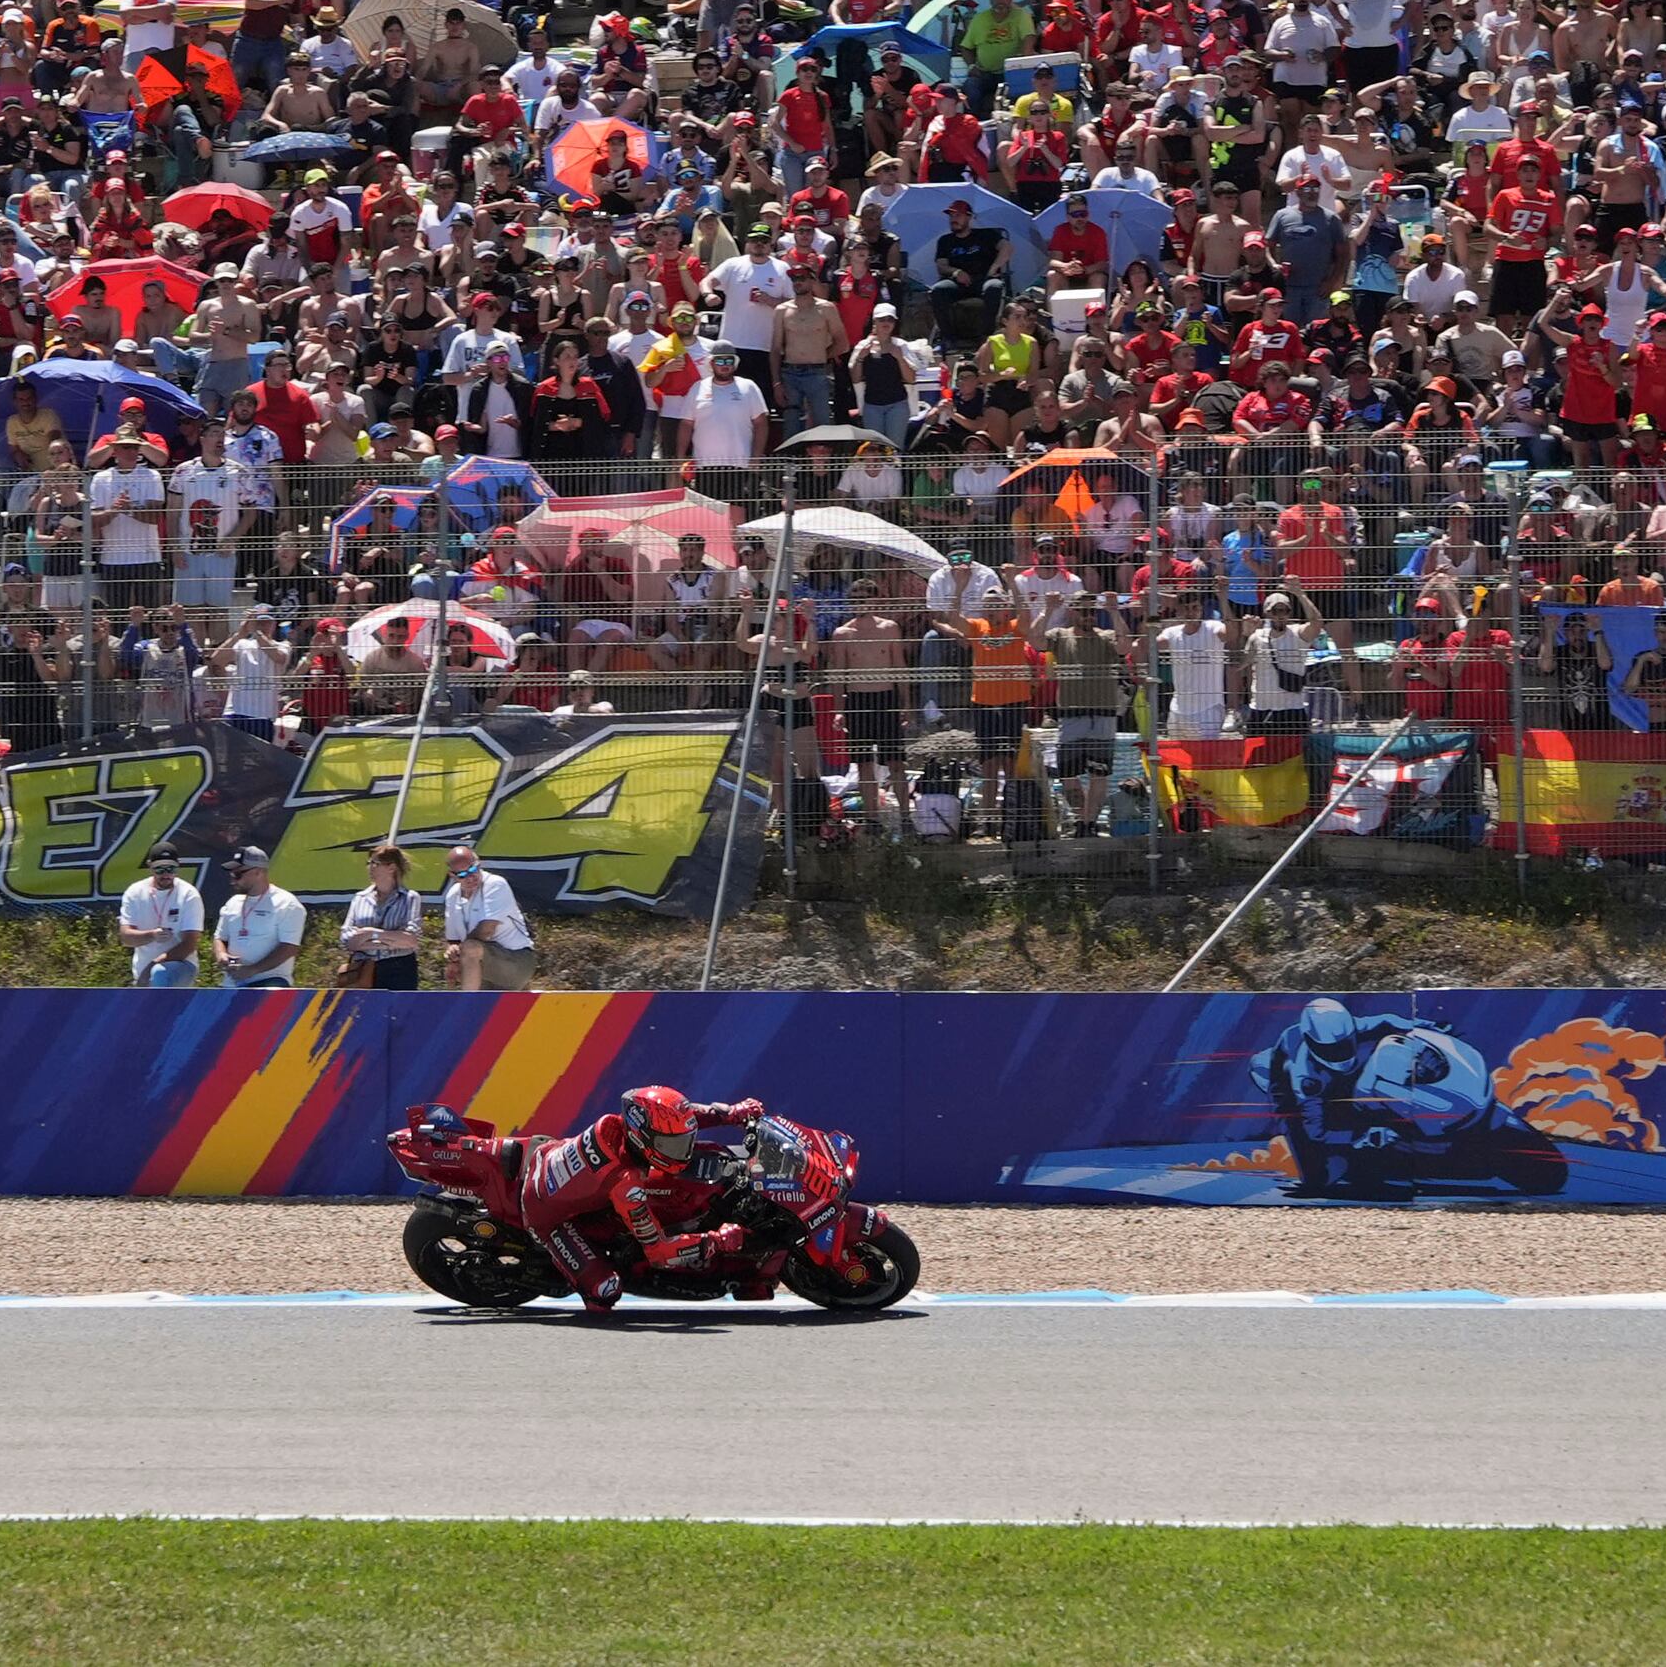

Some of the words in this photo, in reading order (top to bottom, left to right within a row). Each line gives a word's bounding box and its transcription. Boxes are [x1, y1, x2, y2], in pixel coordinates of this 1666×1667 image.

[1510, 209, 1547, 233] 93
[267, 724, 741, 906] 24
[808, 1206, 836, 1230] Lenovo
[549, 1230, 580, 1271] Lenovo
